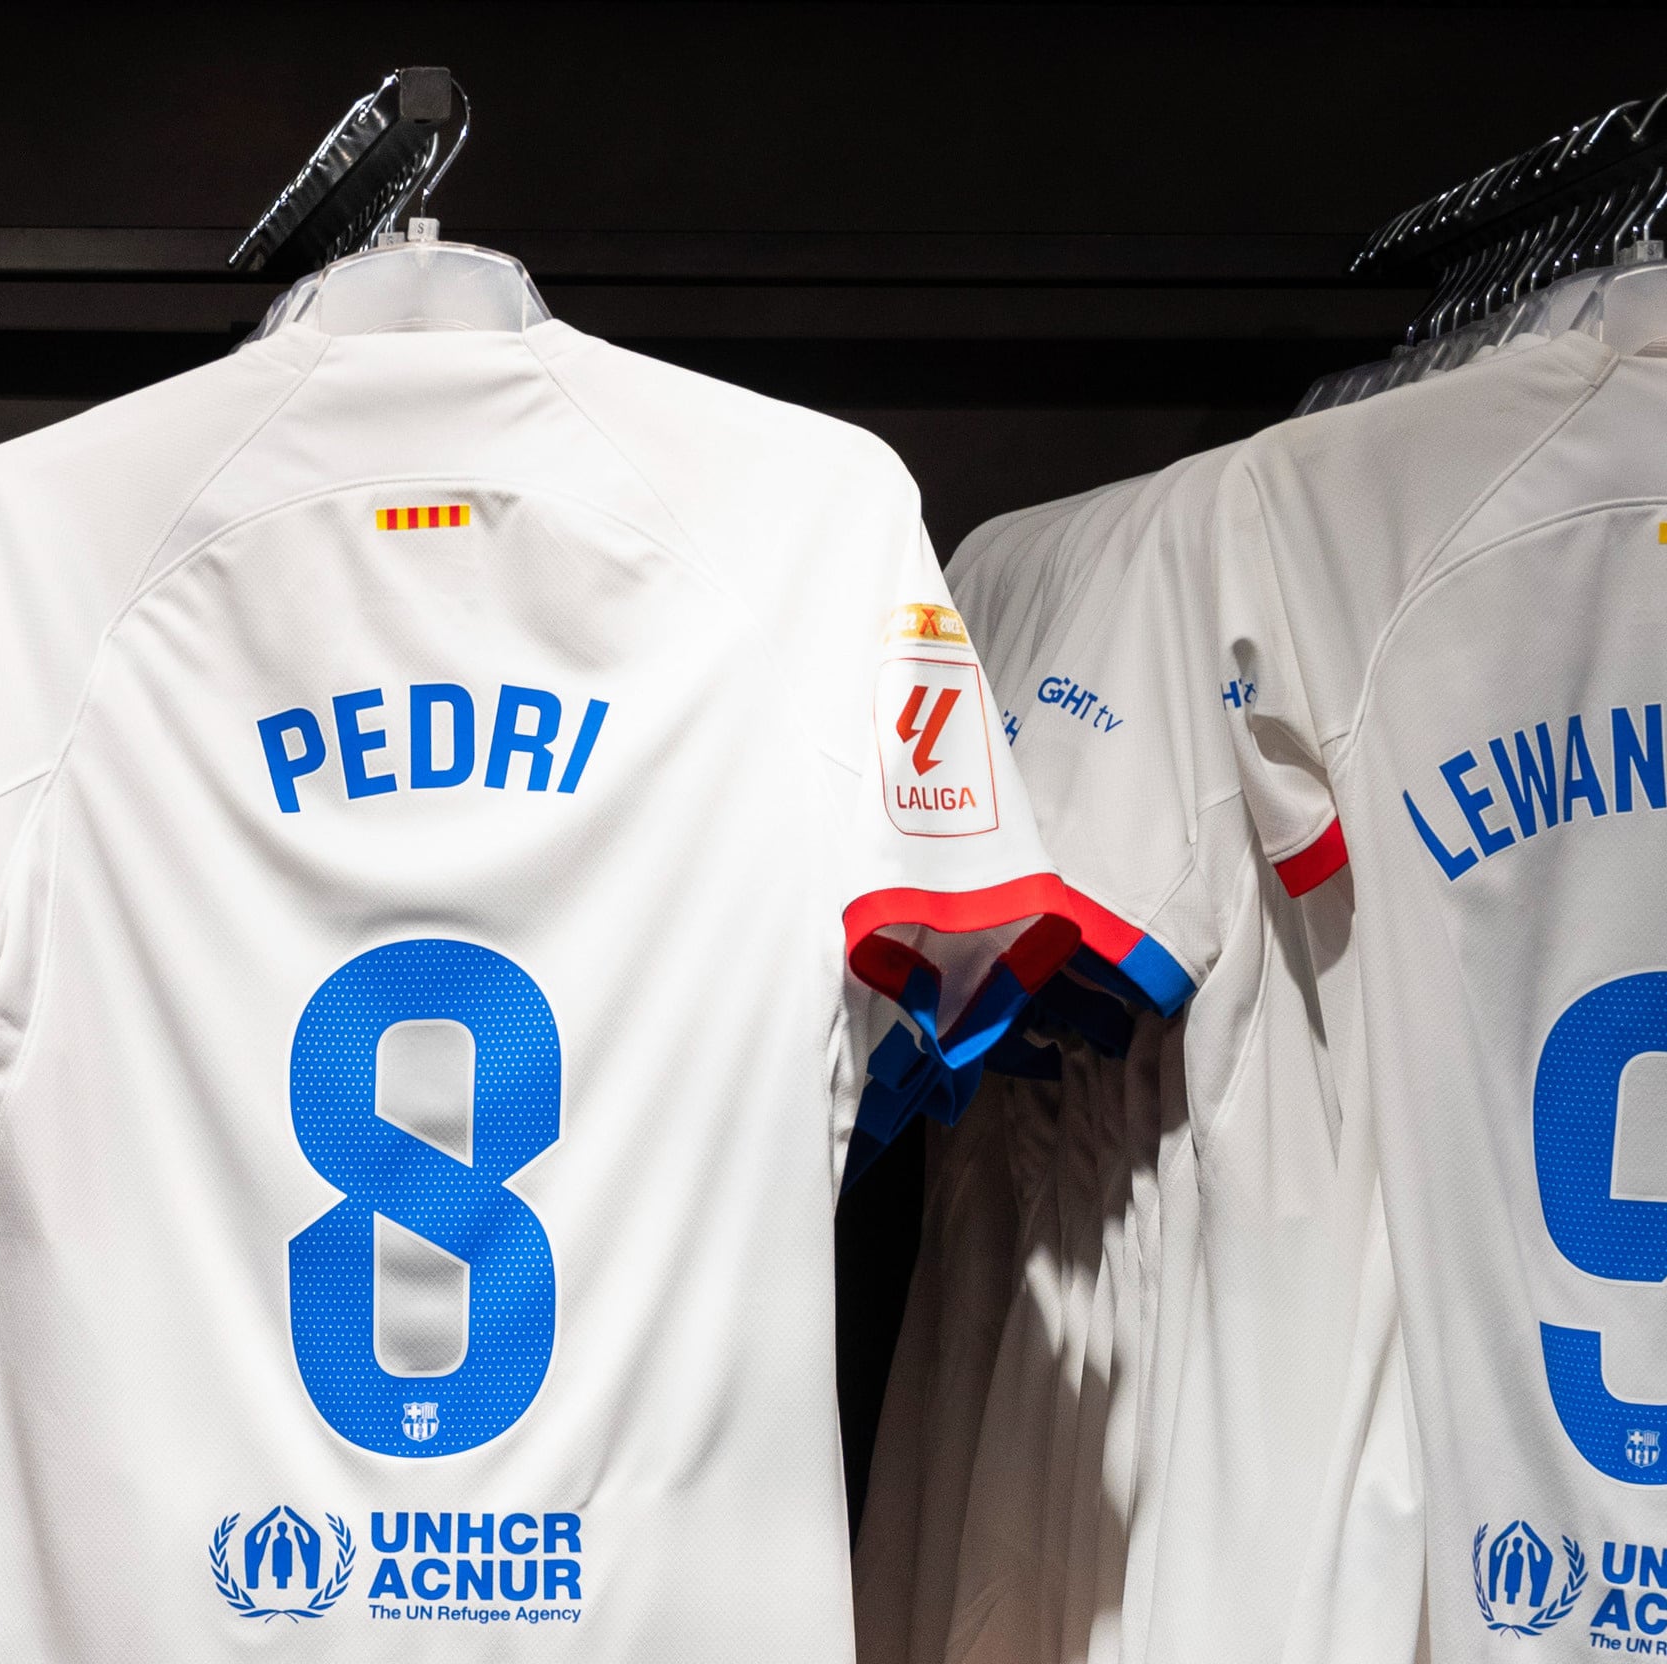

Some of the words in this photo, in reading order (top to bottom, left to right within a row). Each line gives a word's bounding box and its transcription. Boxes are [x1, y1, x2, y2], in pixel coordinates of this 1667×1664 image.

[257, 683, 610, 813] PEDRI
[896, 785, 977, 811] LALIGA
[288, 938, 562, 1459] 8
[371, 1511, 582, 1555] UNHCR
[368, 1558, 582, 1602] ACNUR
[369, 1605, 401, 1619] The
[406, 1606, 433, 1620] UN
[437, 1606, 511, 1624] Refugee
[515, 1607, 582, 1624] Agency
[1590, 1632, 1621, 1650] The
[1626, 1637, 1652, 1654] UN
